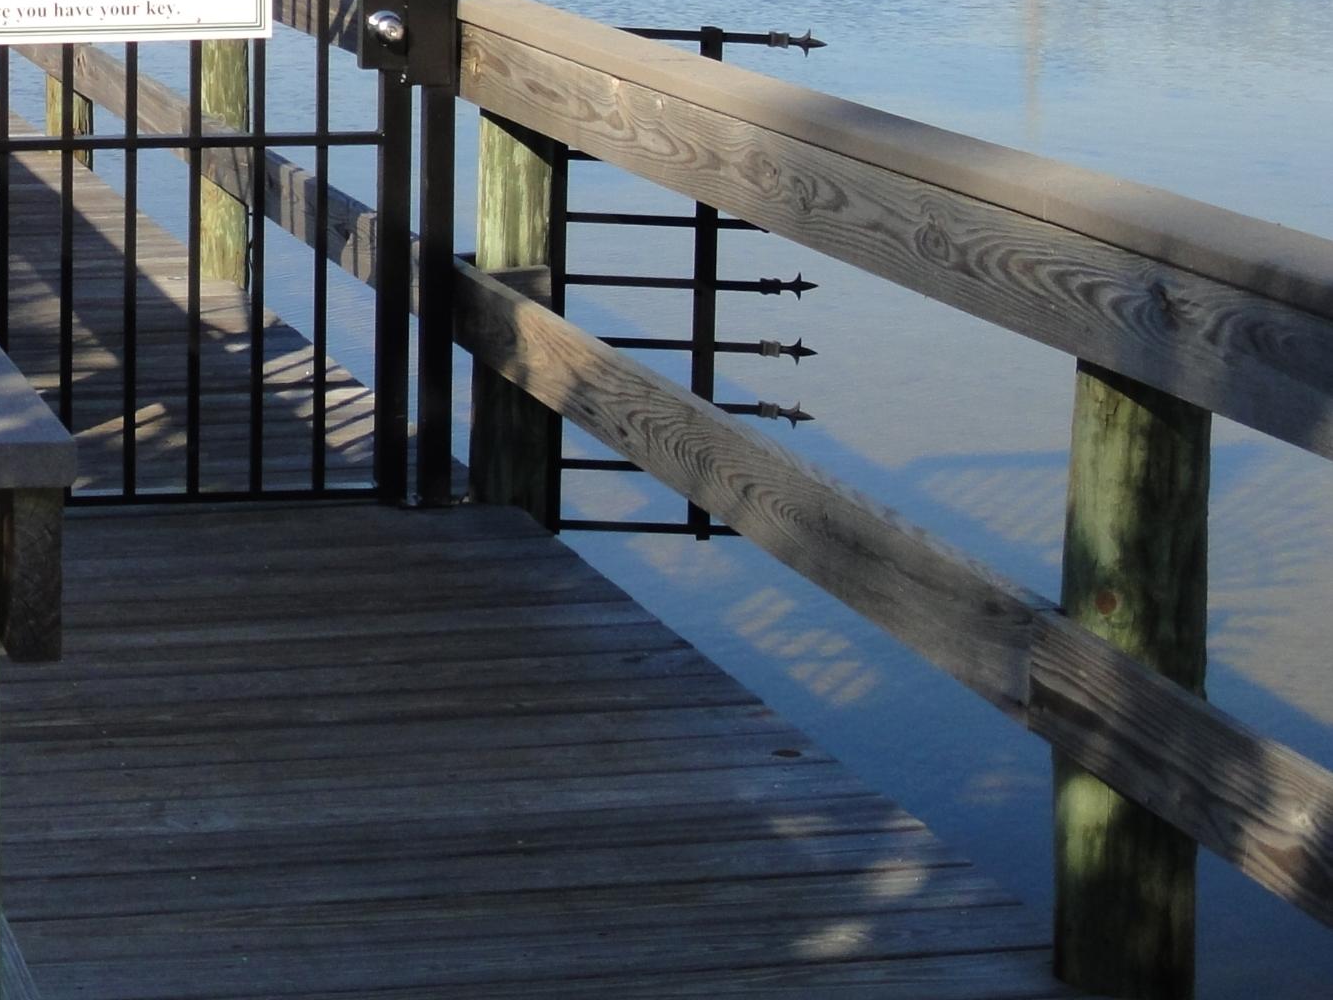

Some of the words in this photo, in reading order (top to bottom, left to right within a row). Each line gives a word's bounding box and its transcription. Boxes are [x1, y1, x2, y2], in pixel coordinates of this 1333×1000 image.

[17, 5, 46, 22] you
[55, 3, 93, 17] have
[100, 3, 139, 20] your
[147, 1, 180, 19] key.
